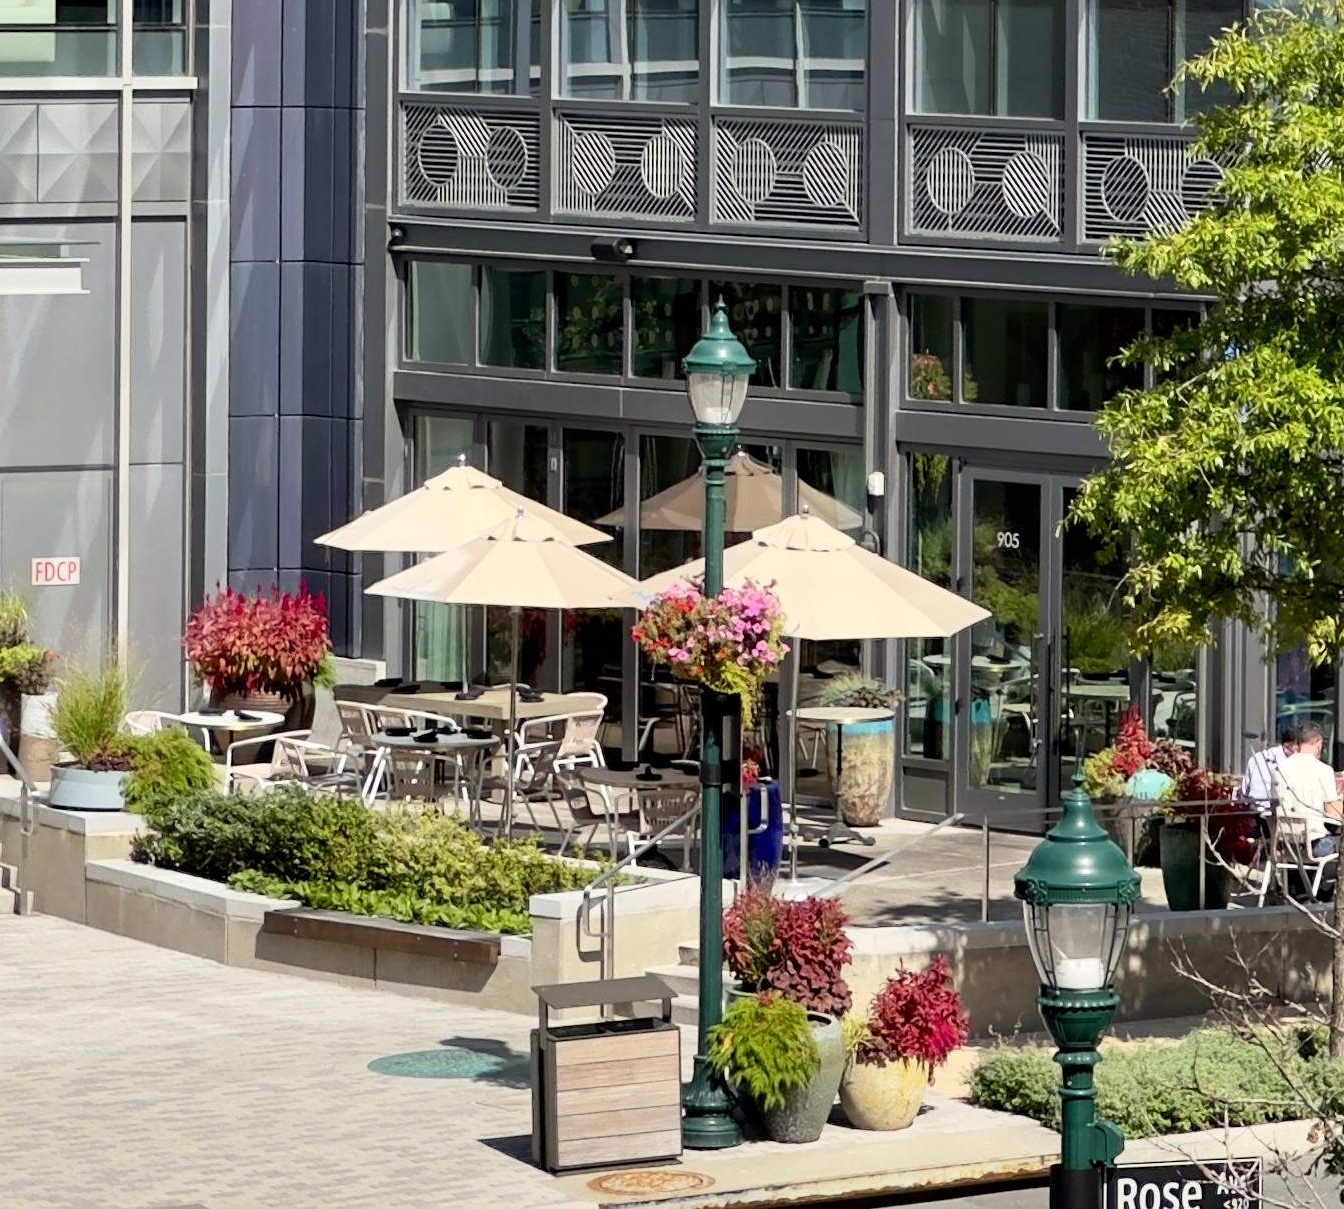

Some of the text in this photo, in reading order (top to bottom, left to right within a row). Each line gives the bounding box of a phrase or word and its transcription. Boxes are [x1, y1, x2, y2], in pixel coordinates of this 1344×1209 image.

[997, 531, 1020, 549] 905
[35, 561, 77, 582] FDCP
[1117, 1177, 1203, 1209] Rose
